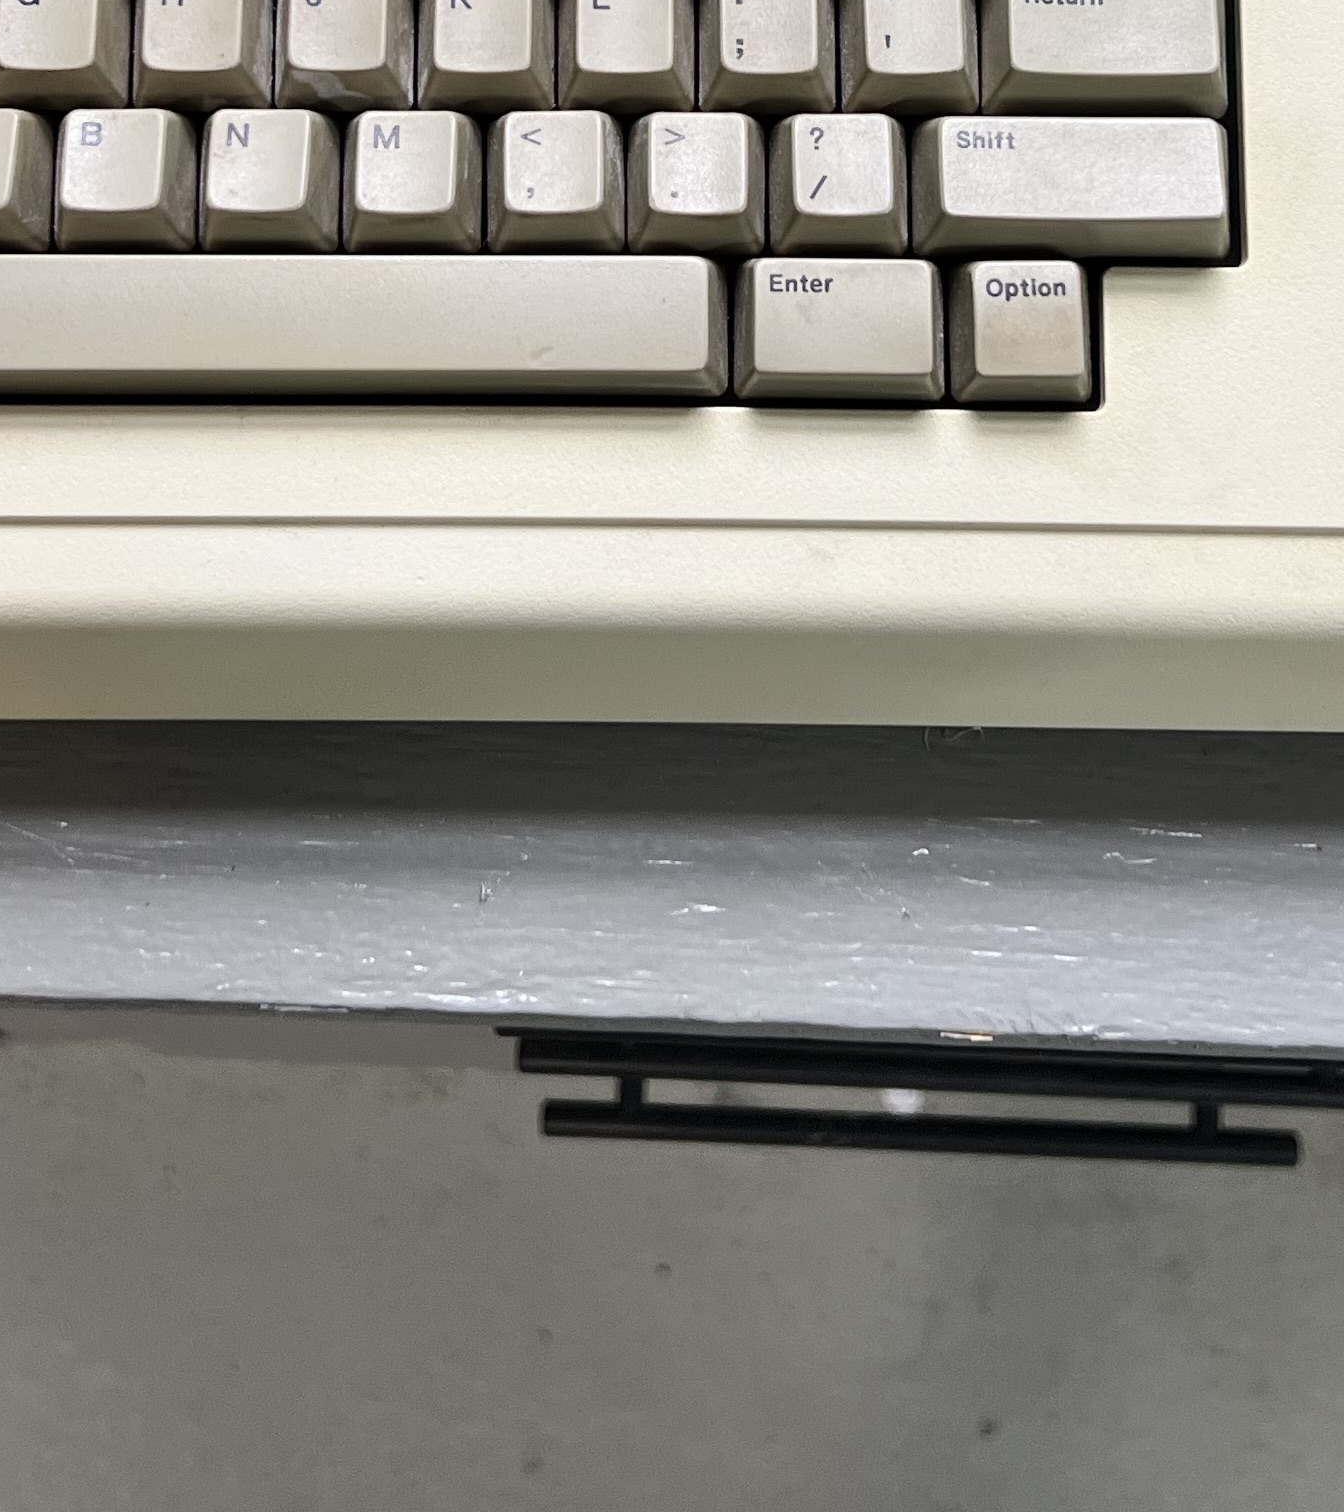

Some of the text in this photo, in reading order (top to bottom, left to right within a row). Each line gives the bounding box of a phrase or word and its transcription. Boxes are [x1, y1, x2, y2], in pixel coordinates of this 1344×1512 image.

[80, 121, 104, 147] B
[225, 122, 250, 148] N
[372, 124, 401, 150] M
[956, 130, 1016, 150] Shift
[769, 273, 834, 294] Enter
[985, 278, 1066, 302] Option
